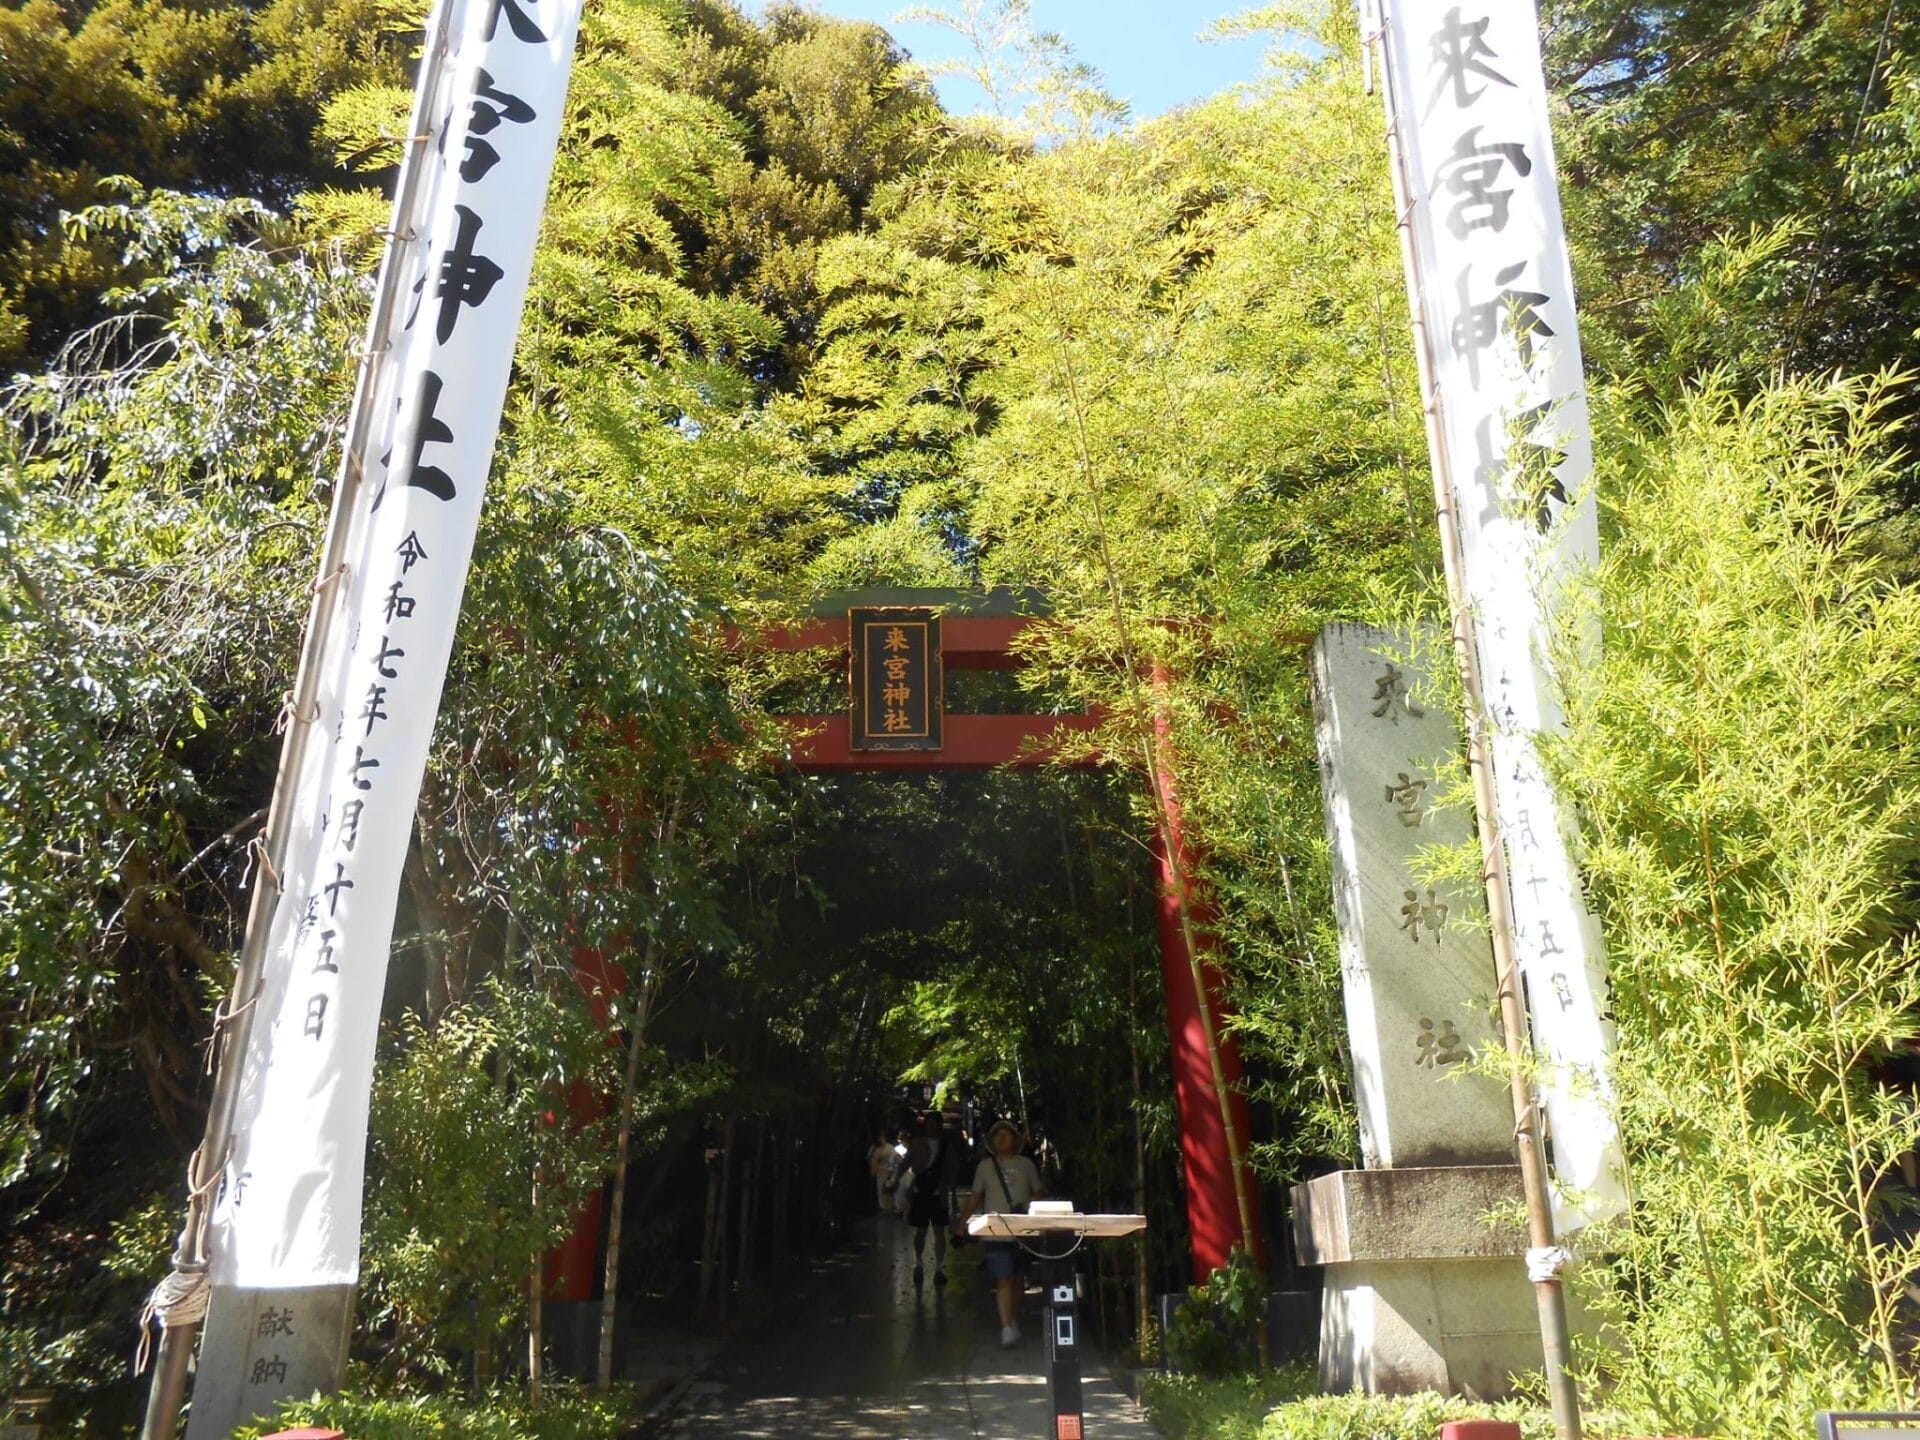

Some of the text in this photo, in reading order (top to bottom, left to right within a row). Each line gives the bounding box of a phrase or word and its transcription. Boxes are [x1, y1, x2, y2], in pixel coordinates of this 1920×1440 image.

[303, 530, 428, 1041] 令和七年七月十五日
[250, 1306, 295, 1385] 献納
